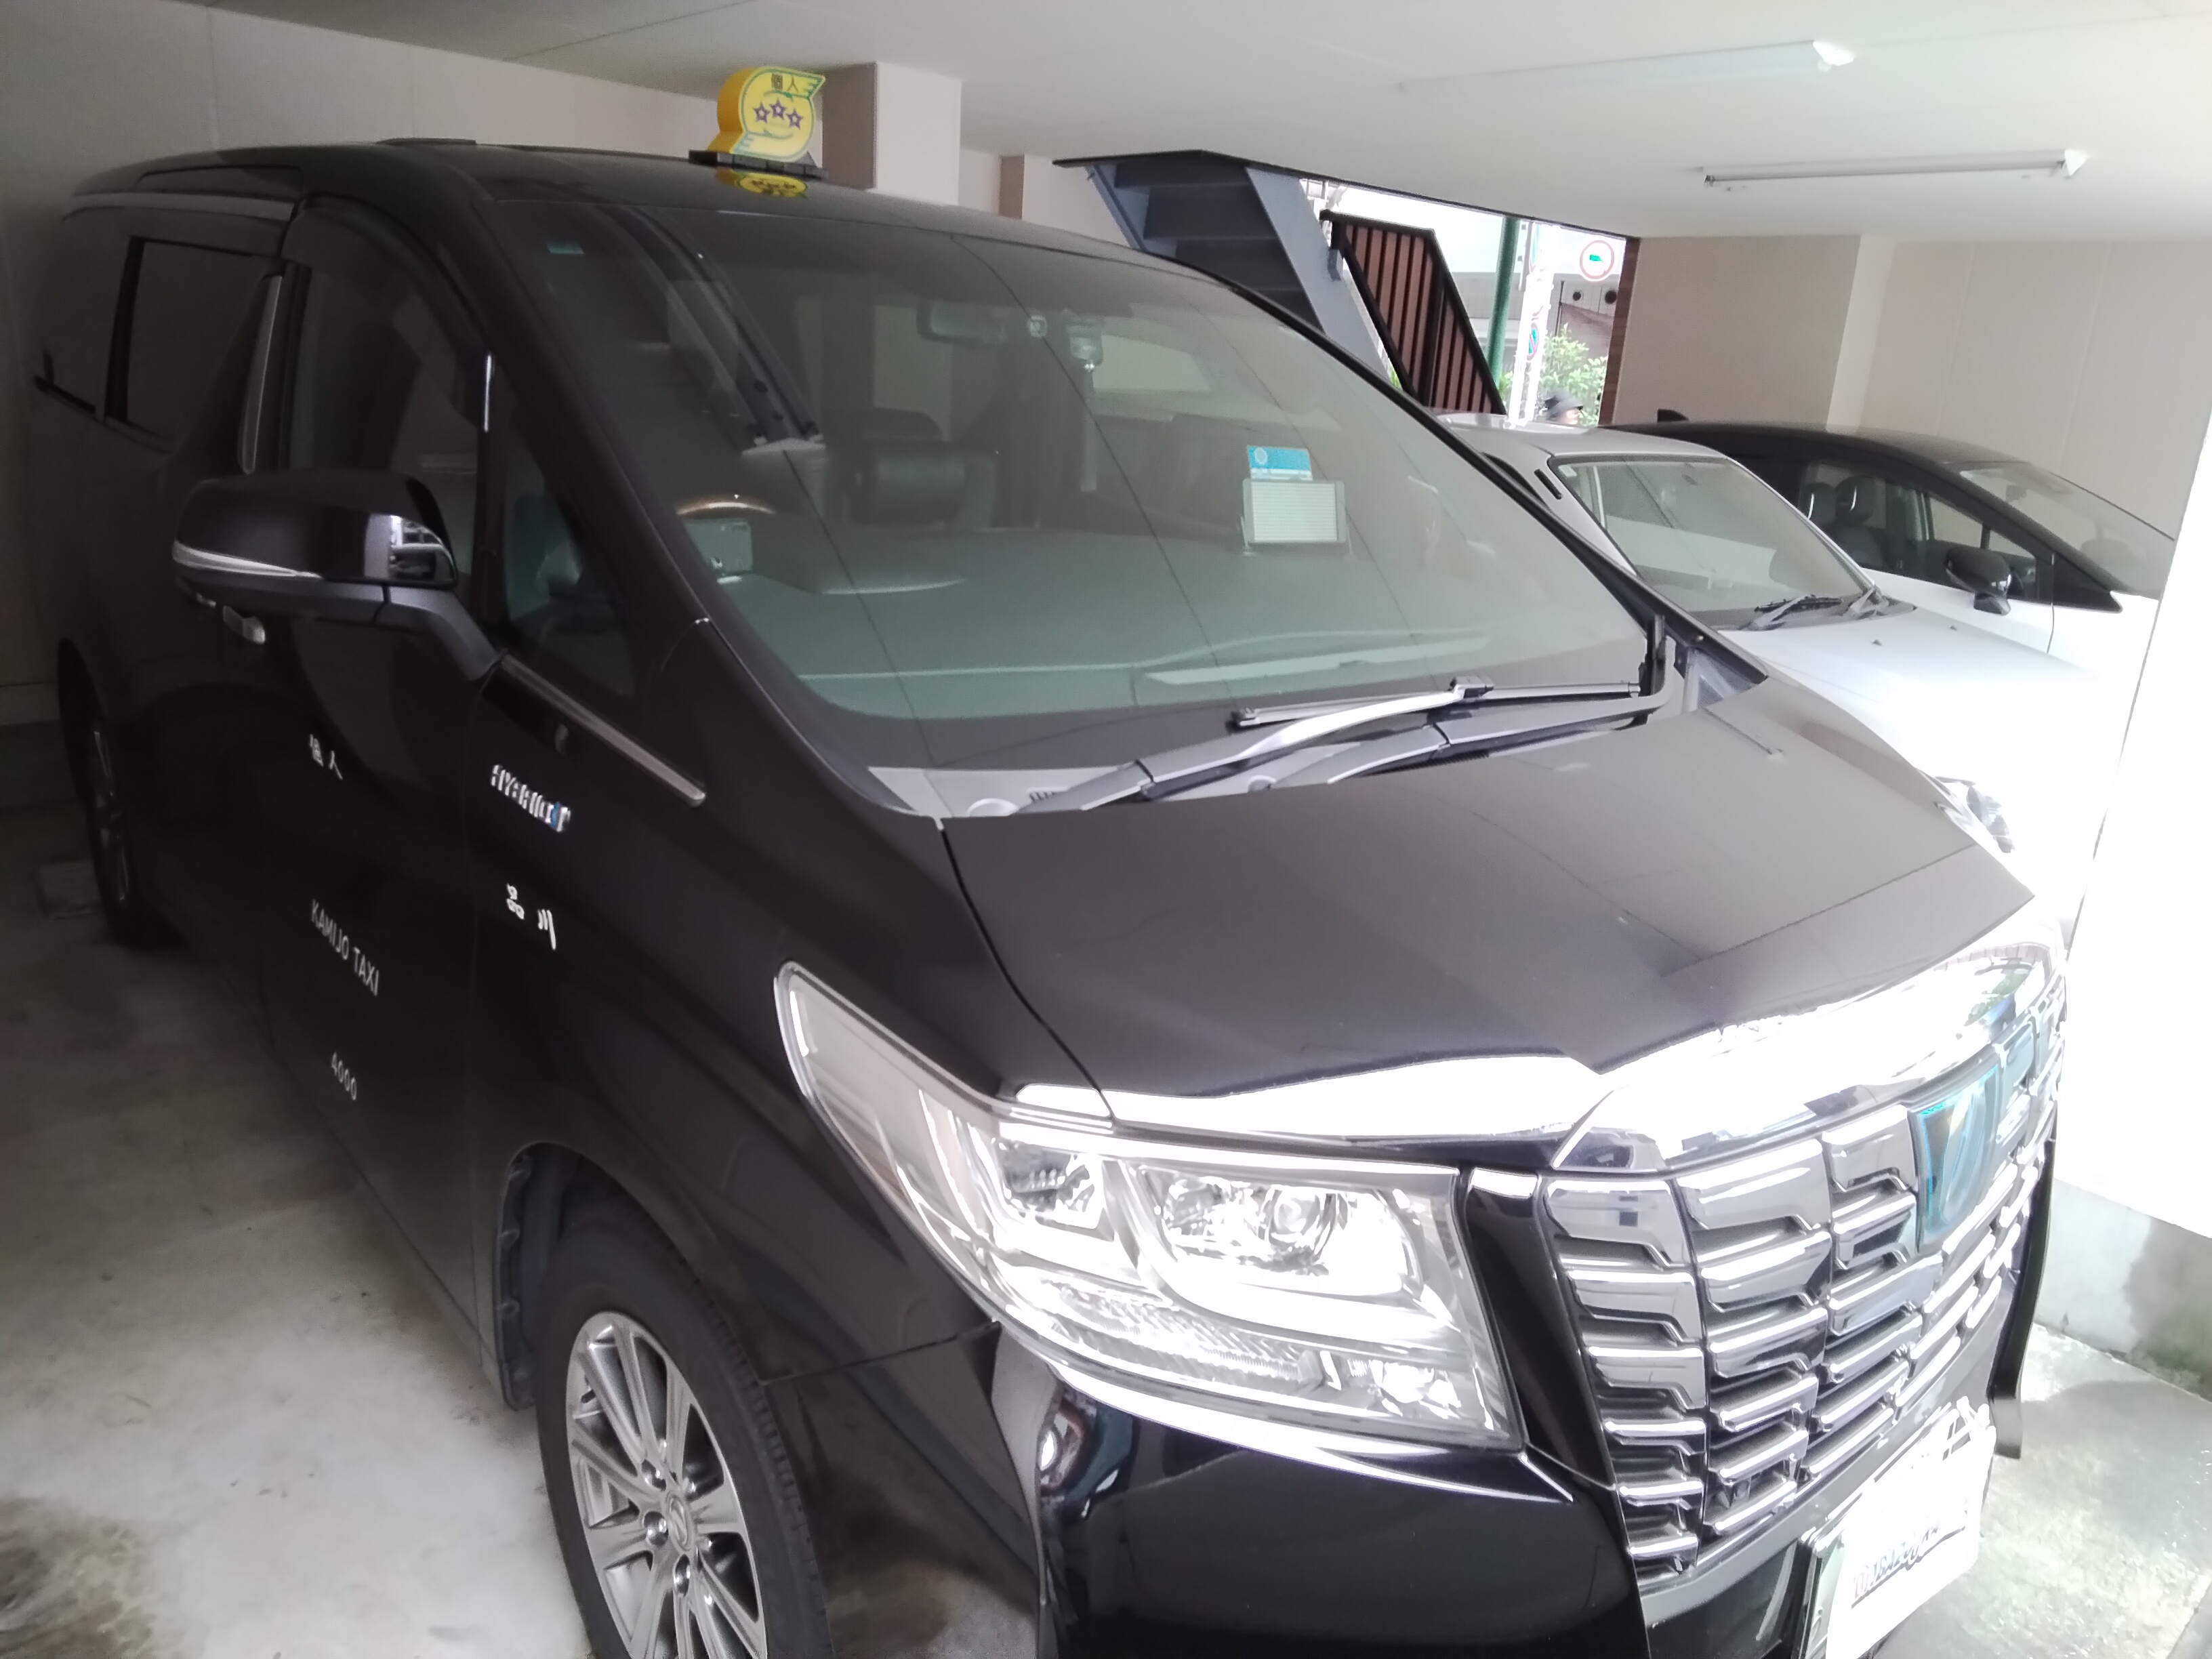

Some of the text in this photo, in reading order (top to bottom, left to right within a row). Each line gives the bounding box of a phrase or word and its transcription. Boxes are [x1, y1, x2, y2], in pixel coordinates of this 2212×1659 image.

[311, 899, 380, 996] KAMIJO TAXI
[331, 1052, 357, 1101] 4000
